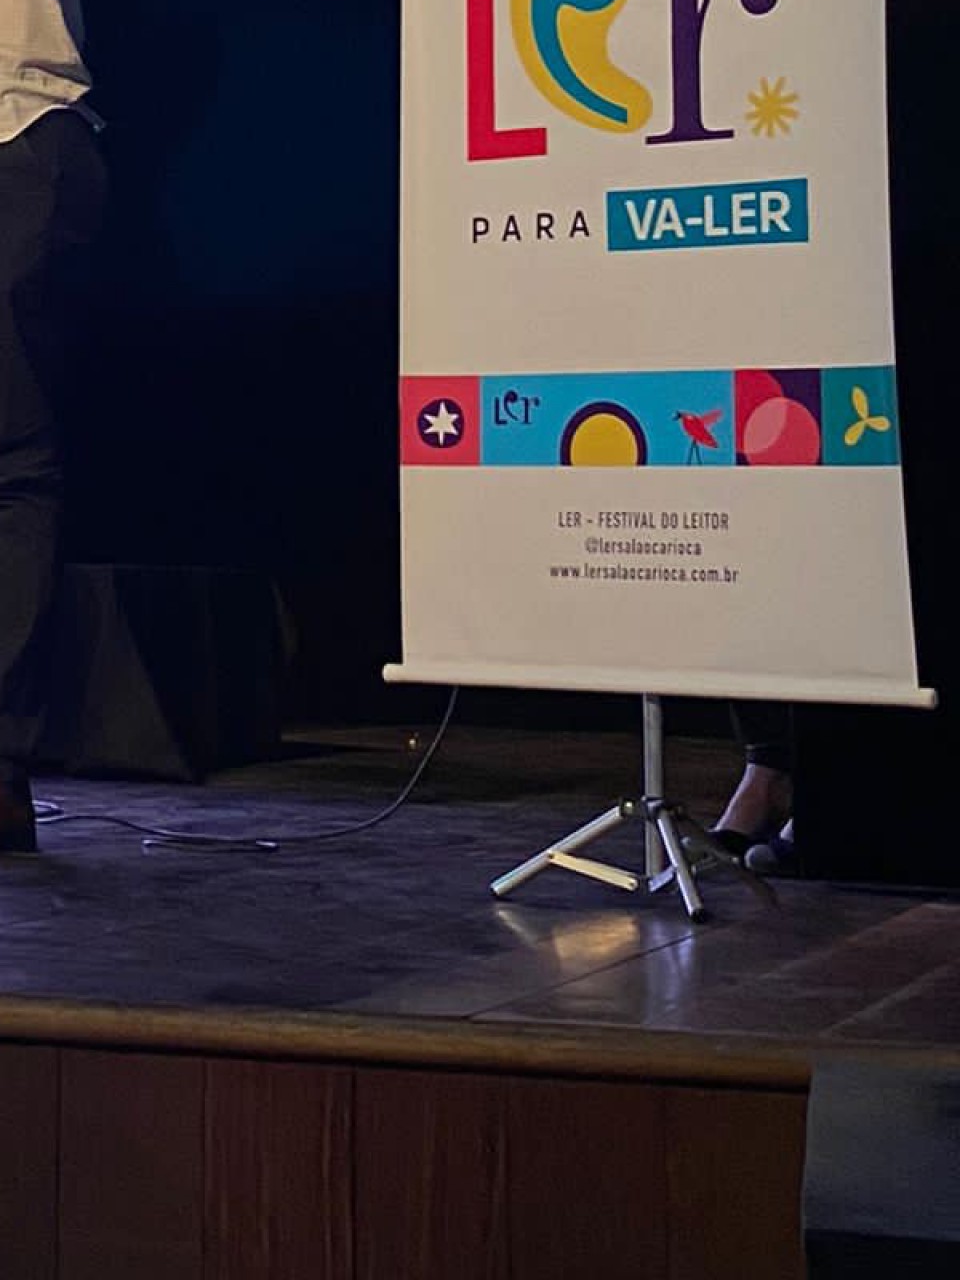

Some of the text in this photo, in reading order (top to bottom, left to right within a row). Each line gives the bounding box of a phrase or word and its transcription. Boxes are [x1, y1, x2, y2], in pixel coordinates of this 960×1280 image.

[471, 190, 793, 244] PARA VA-LER
[557, 511, 582, 528] LER
[597, 511, 656, 529] FESTIVAL
[660, 512, 679, 529] DO
[682, 512, 730, 530] LEITOR
[584, 537, 703, 556] @lersalaocarioca
[549, 563, 740, 583] www.lersalaocarioca.com.br
